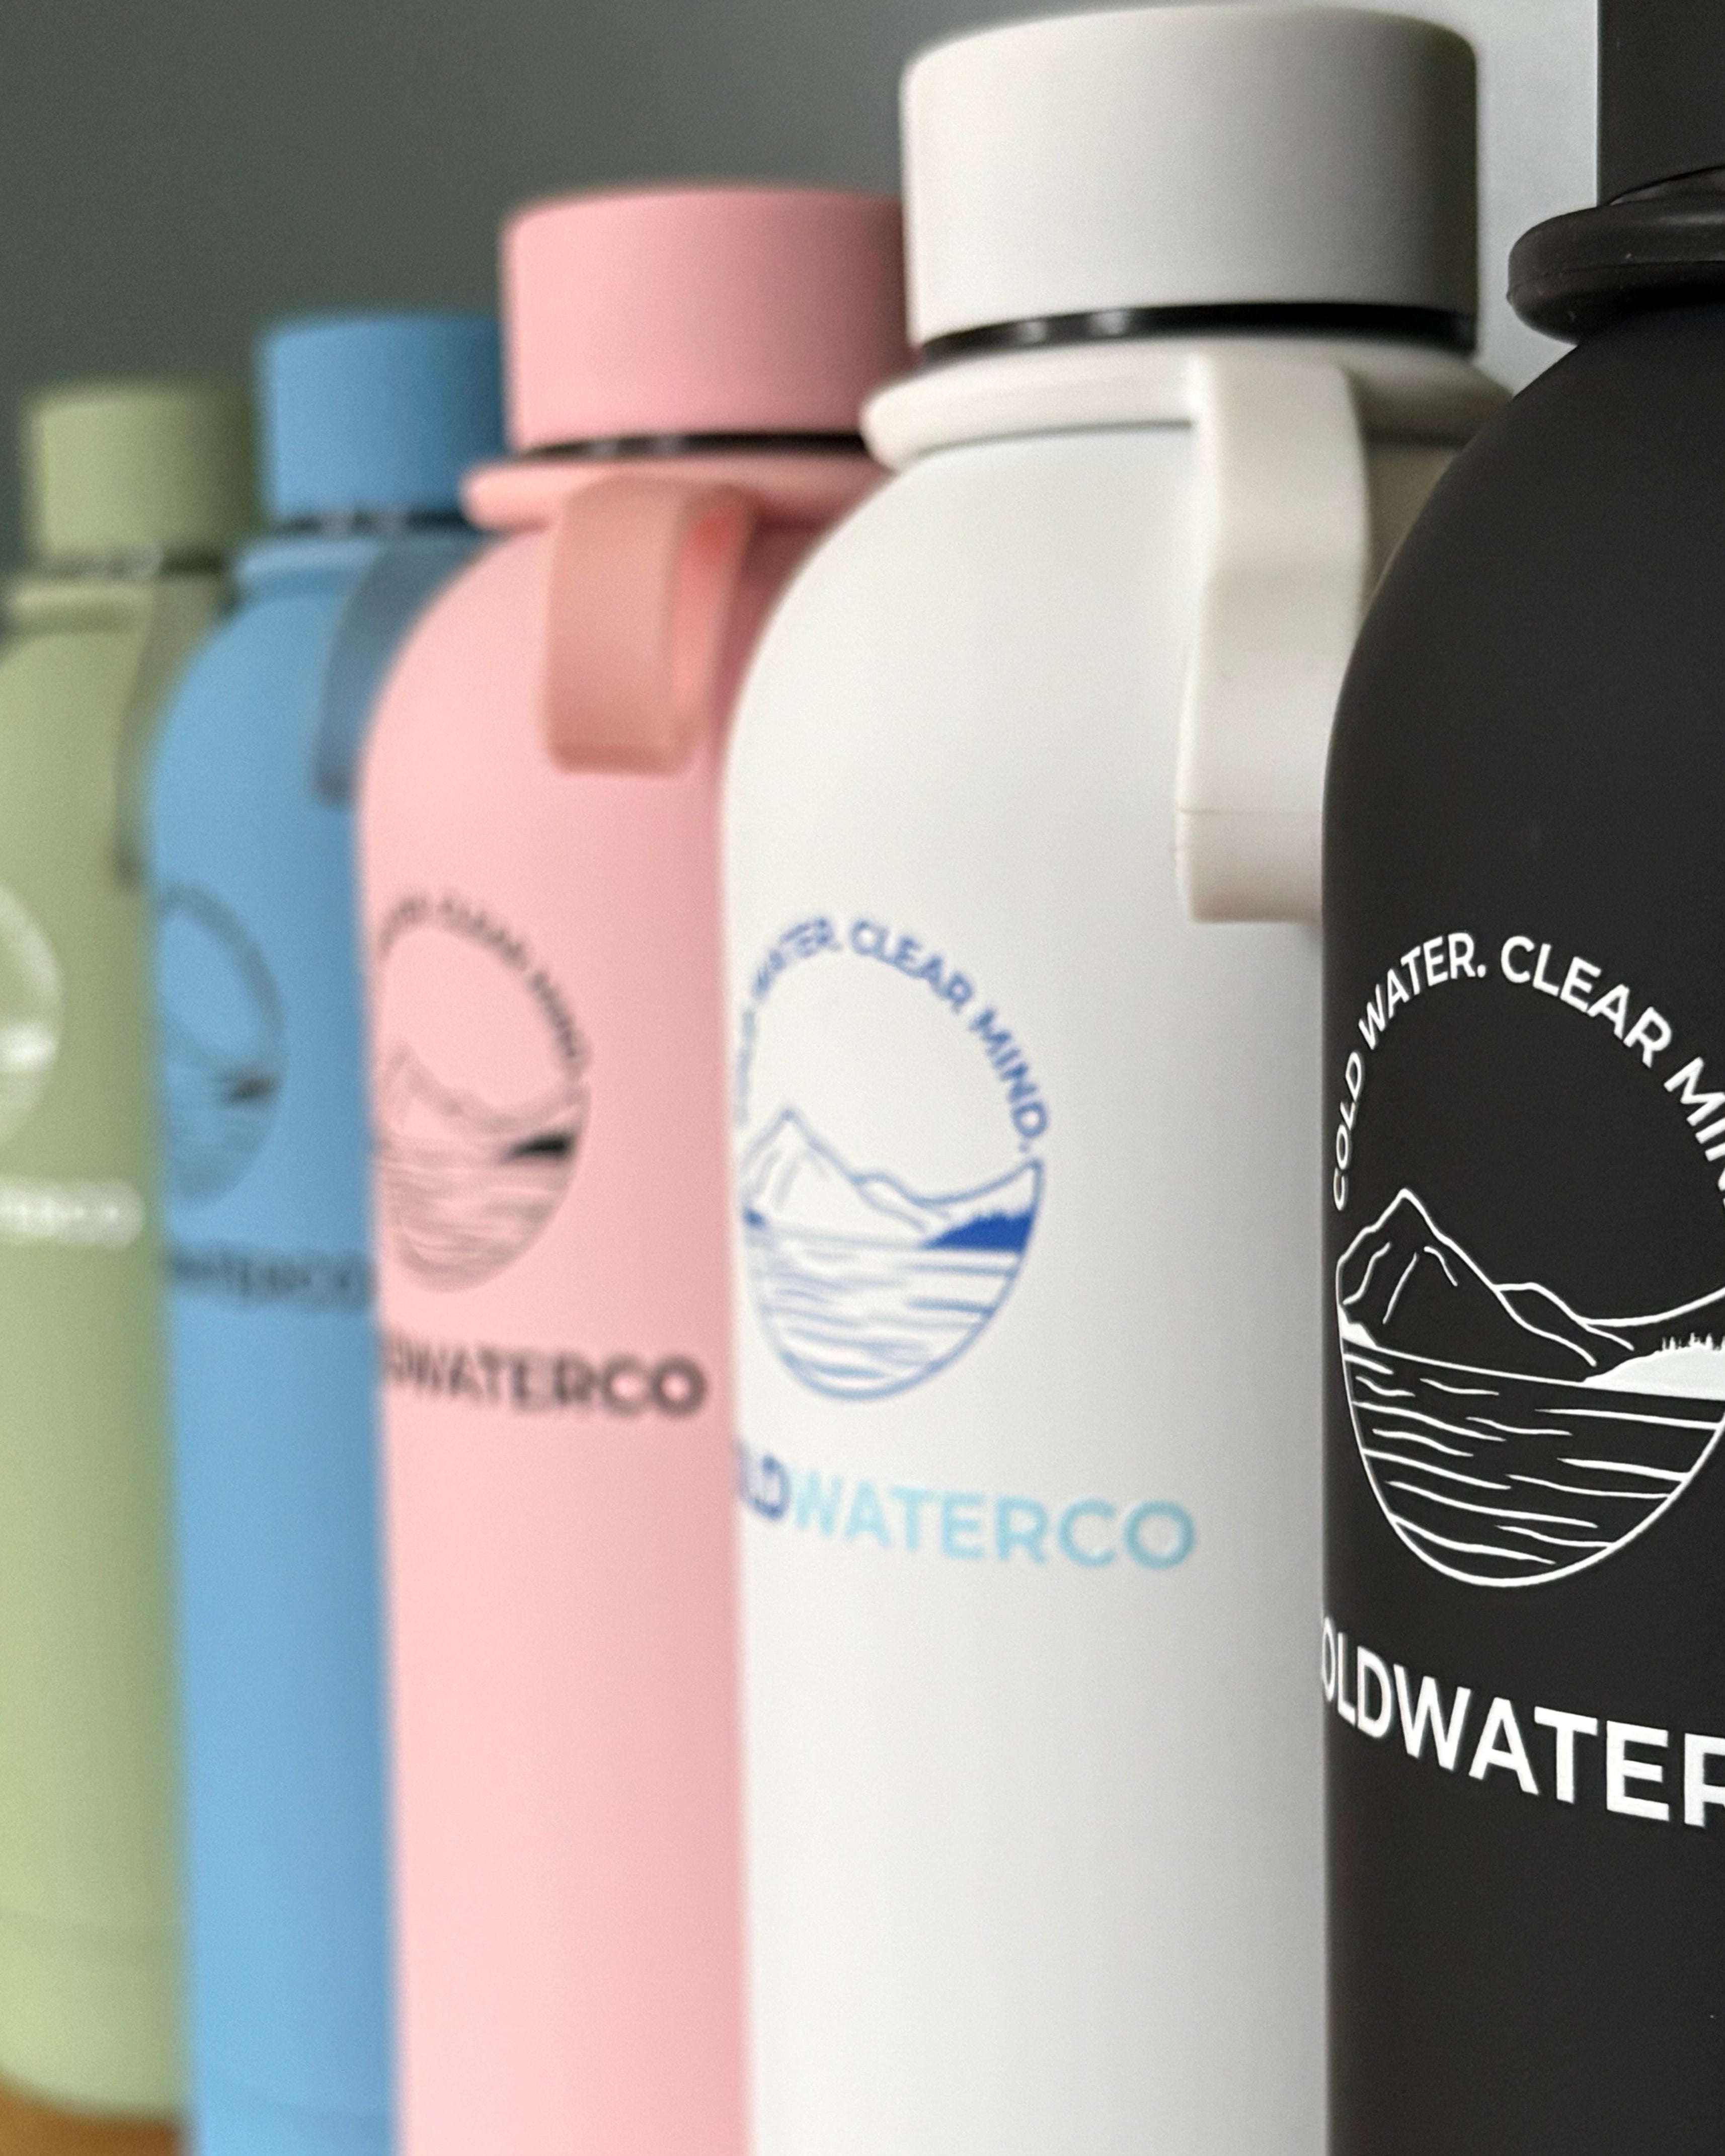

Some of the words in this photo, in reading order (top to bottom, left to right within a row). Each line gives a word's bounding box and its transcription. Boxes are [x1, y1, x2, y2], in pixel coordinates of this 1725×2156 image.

[849, 919, 975, 1015] CLEAR
[1333, 1051, 1365, 1211] COLD
[1358, 932, 1486, 1050] WATER.
[1501, 936, 1673, 1068] CLEAR
